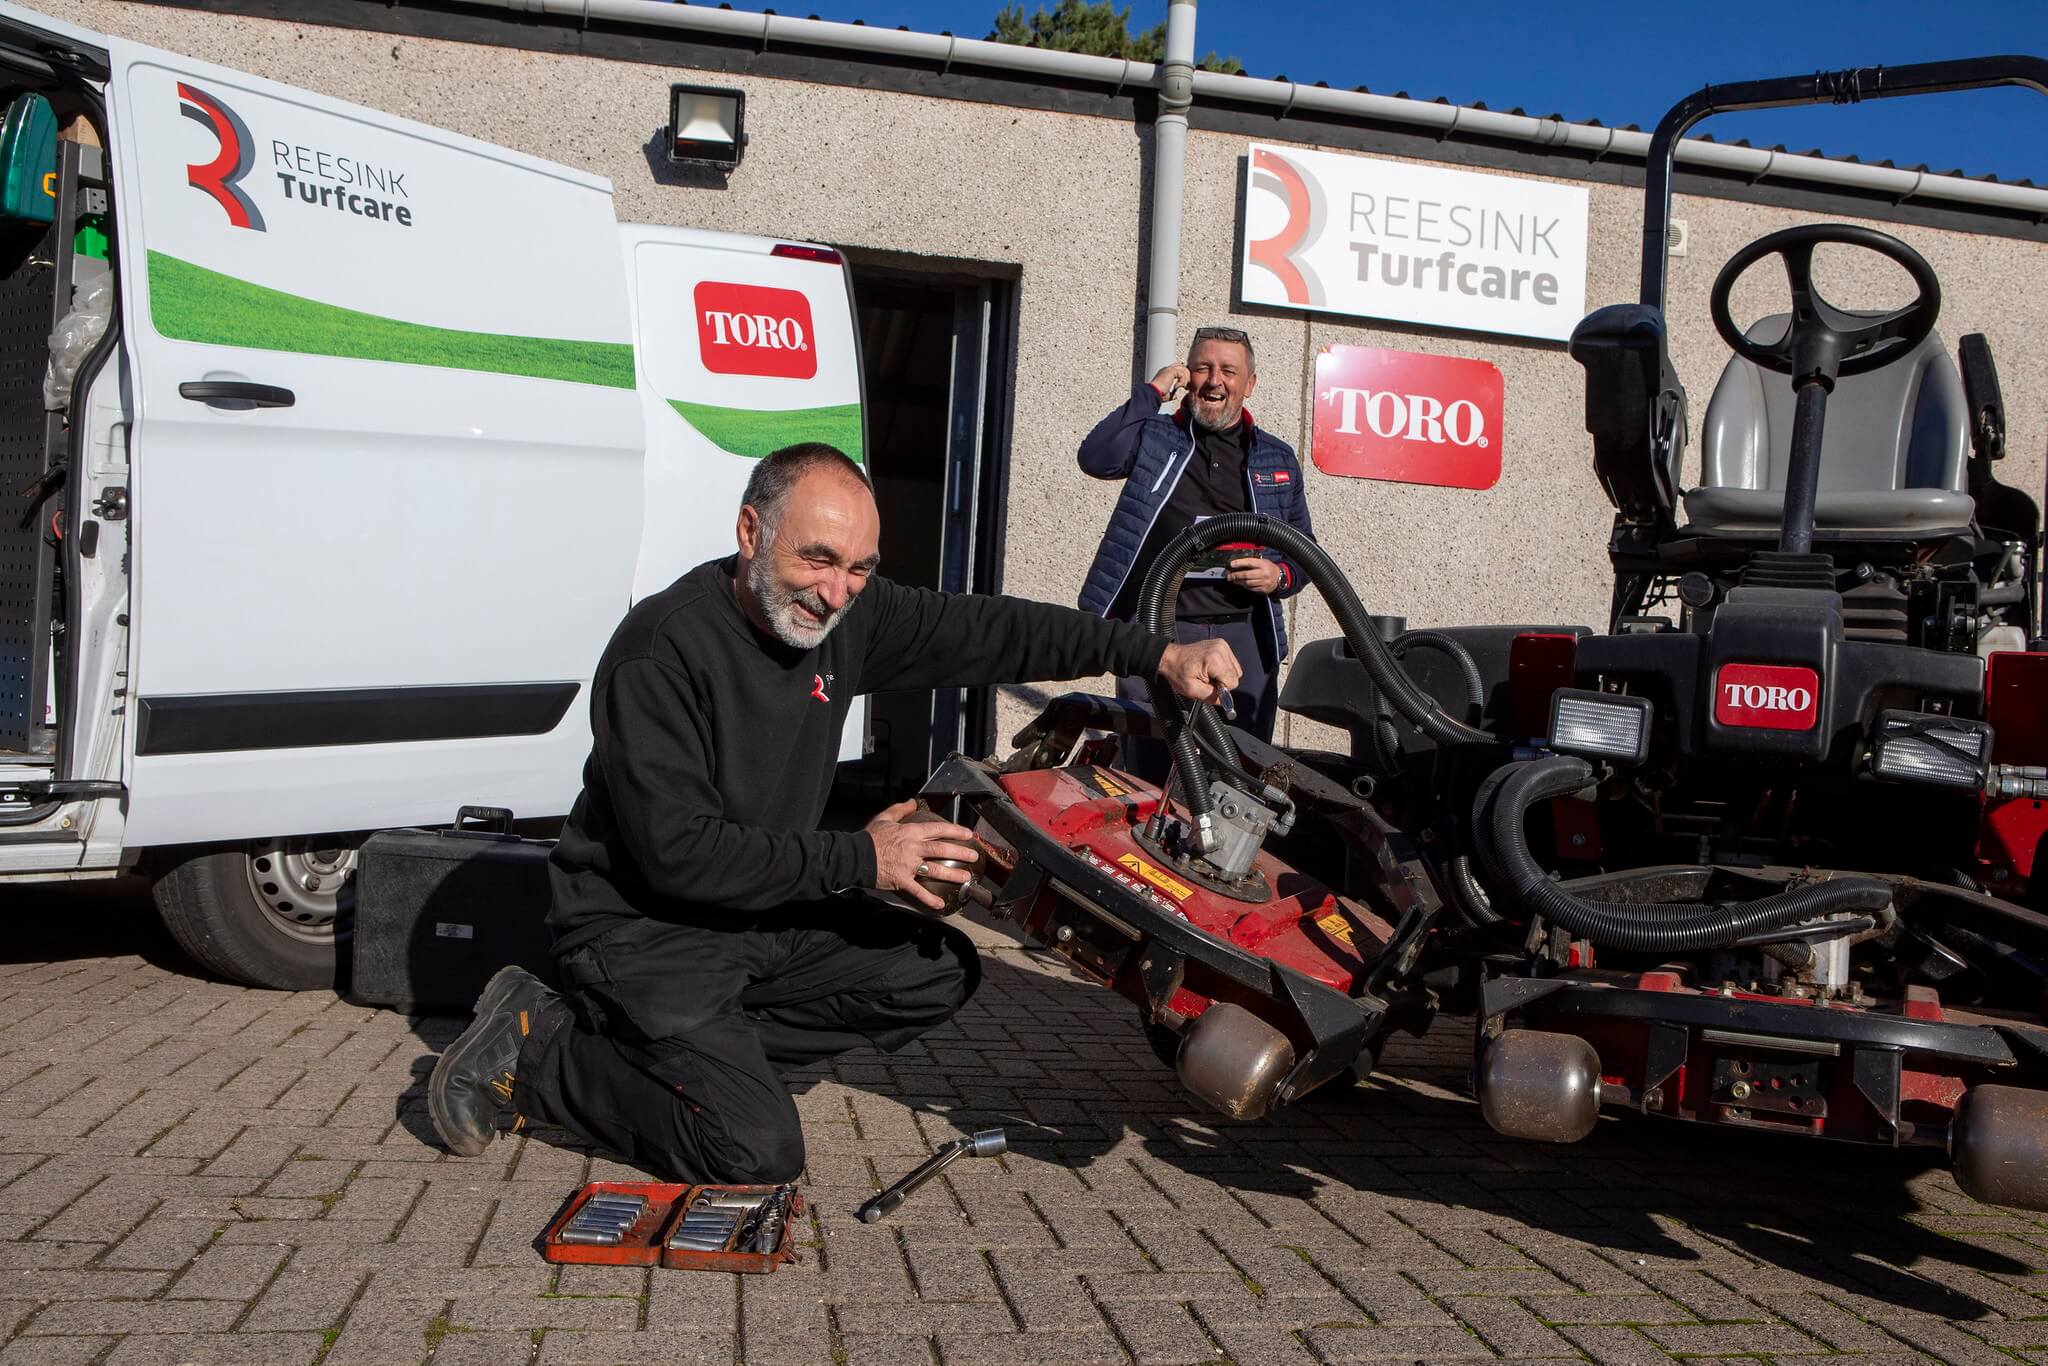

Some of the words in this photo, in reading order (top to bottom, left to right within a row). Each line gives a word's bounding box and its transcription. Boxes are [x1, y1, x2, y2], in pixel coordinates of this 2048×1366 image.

[272, 139, 408, 198] REESINK
[277, 172, 412, 227] Turfcare
[1350, 191, 1559, 259] REESINK
[1350, 241, 1558, 305] Turfcare
[1725, 684, 1811, 711] TORO
